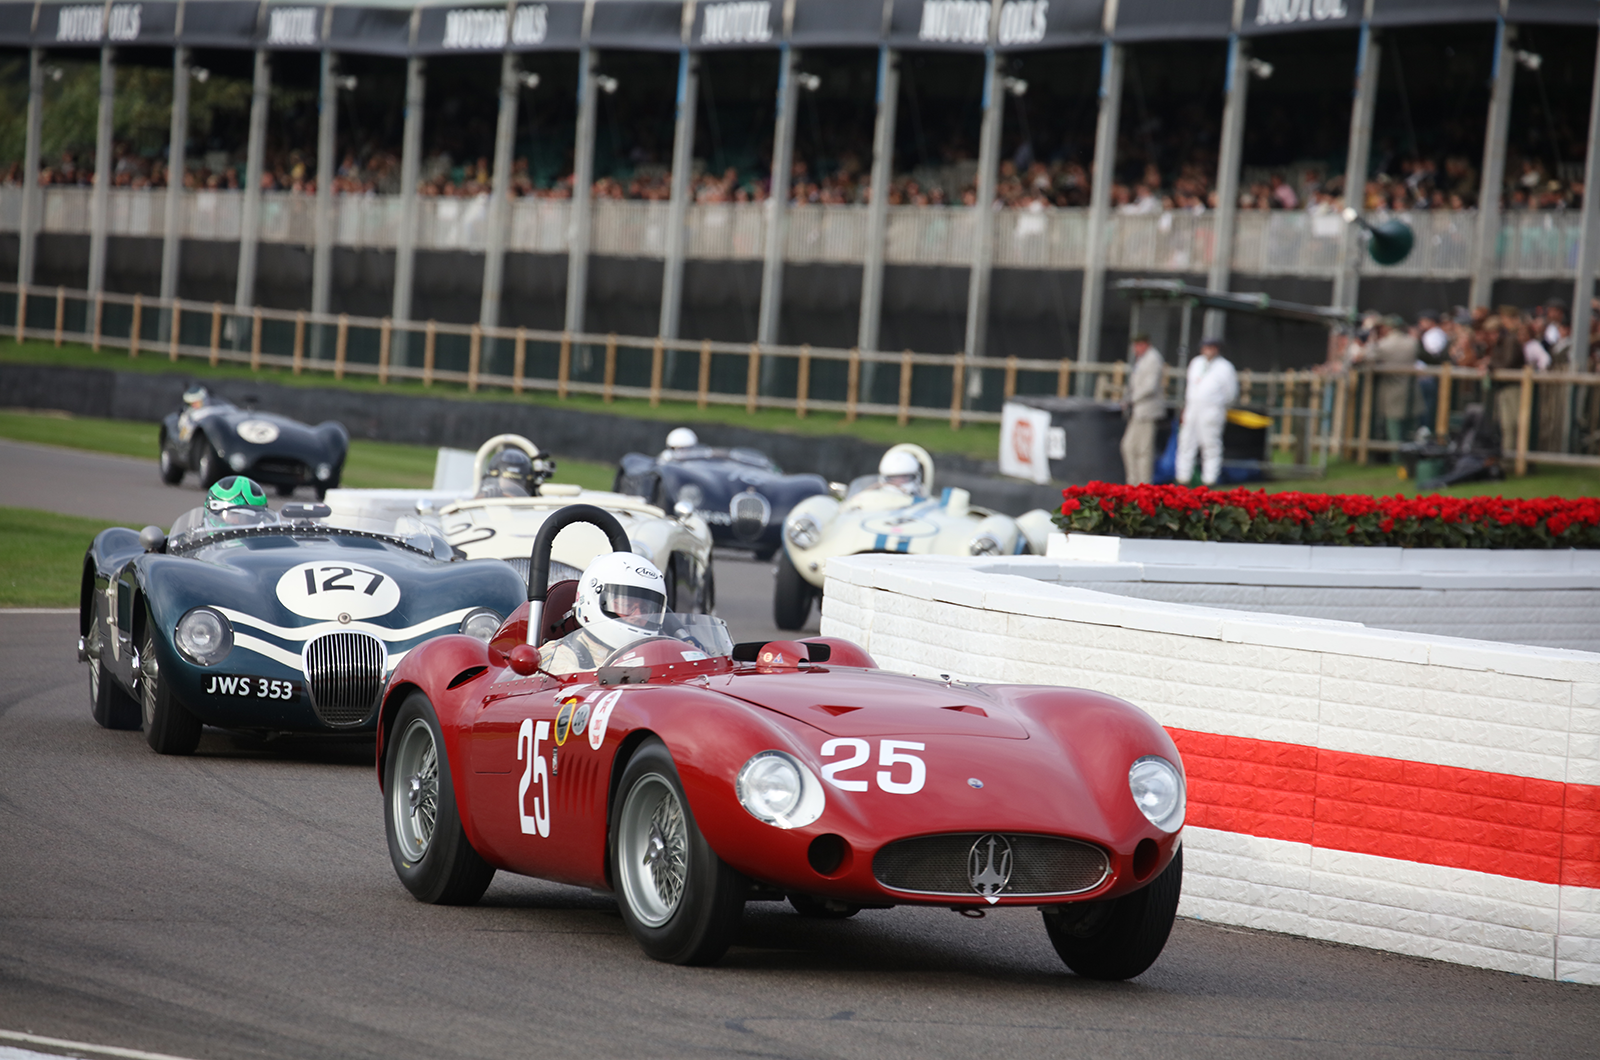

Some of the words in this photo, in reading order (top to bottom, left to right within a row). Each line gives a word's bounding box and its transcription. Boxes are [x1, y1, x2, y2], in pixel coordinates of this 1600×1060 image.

[442, 9, 509, 48] MOTOR
[701, 1, 773, 44] MOTUL
[919, 0, 990, 43] MOTOR
[998, 0, 1049, 45] OILS
[304, 567, 384, 596] 127
[206, 676, 250, 696] JWS
[256, 678, 293, 700] 353
[517, 718, 550, 838] 25
[820, 738, 926, 794] 25
